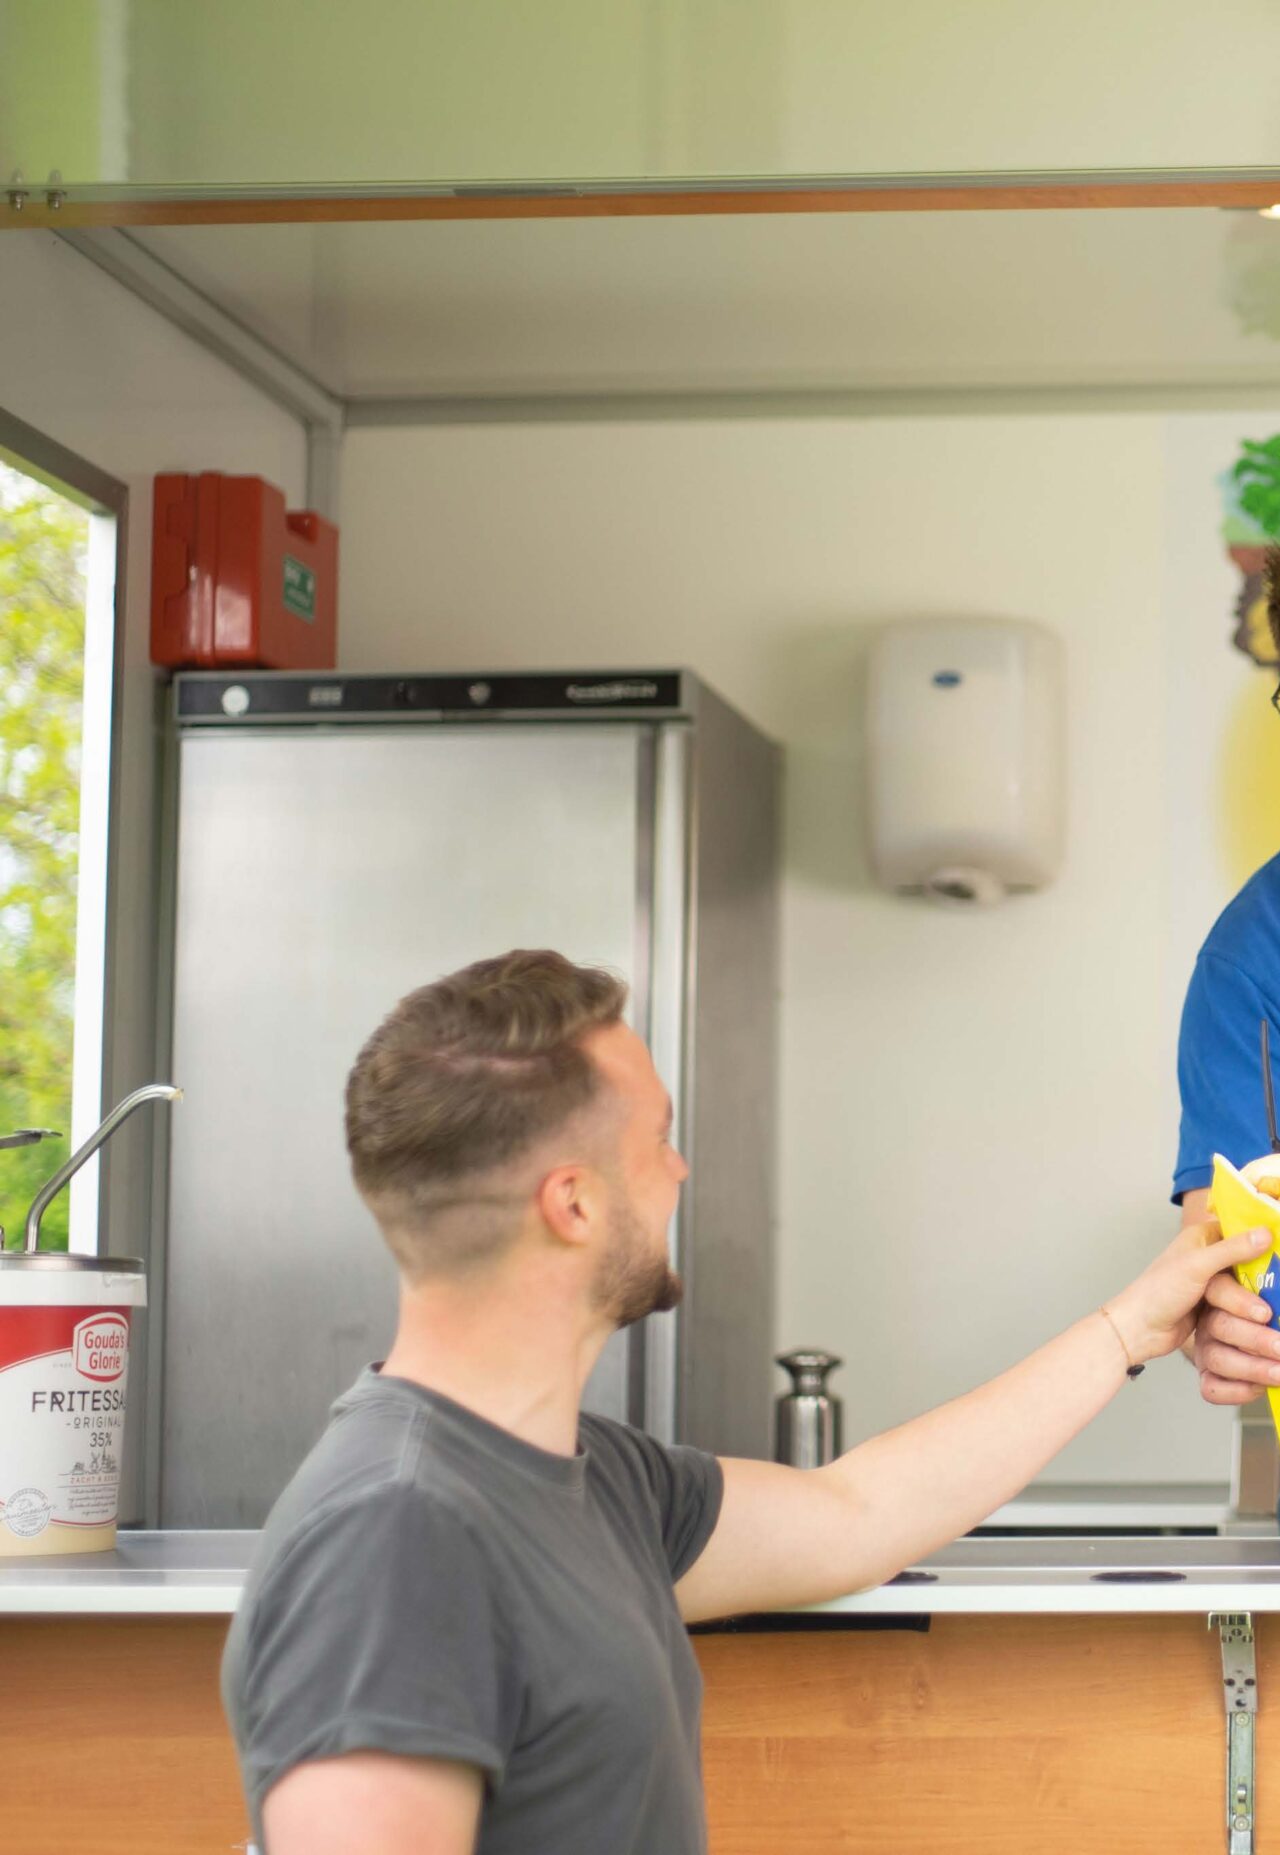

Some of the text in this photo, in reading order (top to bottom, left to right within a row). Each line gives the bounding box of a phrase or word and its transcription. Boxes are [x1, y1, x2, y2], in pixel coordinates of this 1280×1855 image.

[84, 1329, 125, 1349] Gouda's
[89, 1351, 121, 1370] Glorie
[32, 1389, 127, 1412] FRITESSA
[90, 1432, 112, 1447] 35%
